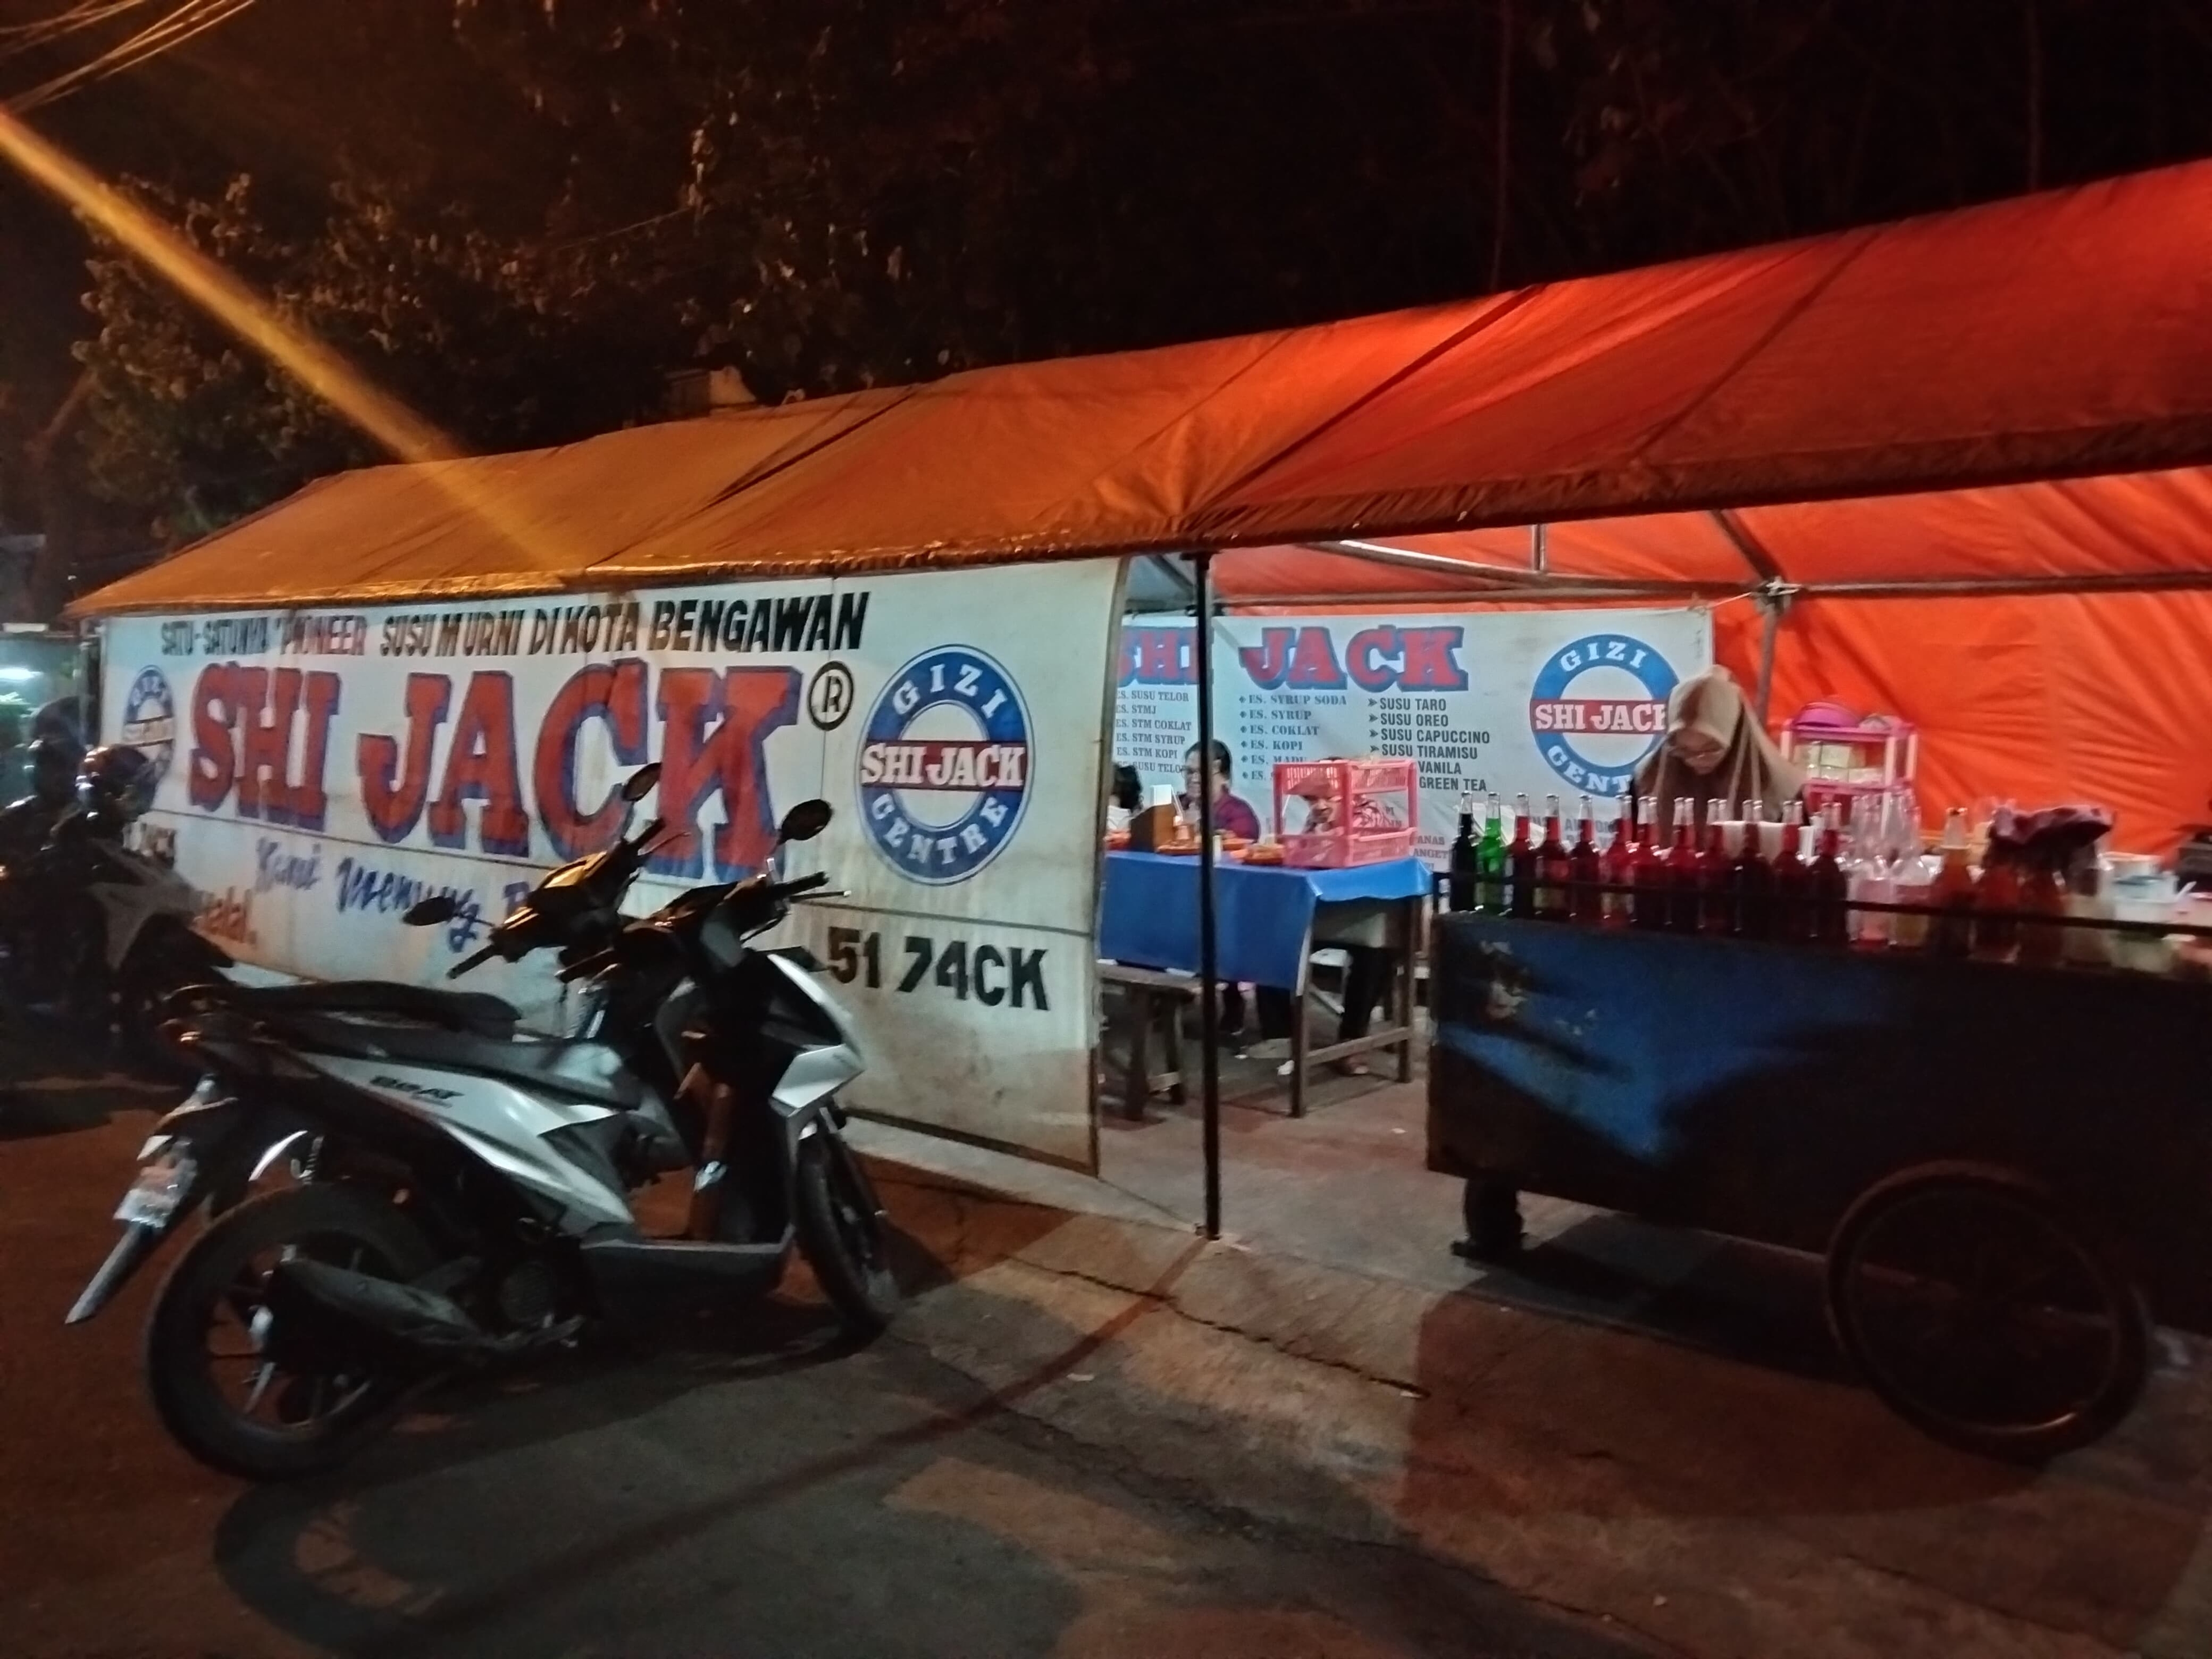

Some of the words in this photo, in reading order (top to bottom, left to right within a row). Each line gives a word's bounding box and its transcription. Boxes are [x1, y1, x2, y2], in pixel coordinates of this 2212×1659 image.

[380, 613, 437, 657] SUSU
[559, 601, 641, 653] KOTA
[647, 591, 870, 653] BENGAWAN
[1238, 624, 1469, 692] JACK
[1560, 641, 1648, 672] GIZI
[892, 664, 1007, 718] GIZI
[1131, 690, 1156, 700] SUSU
[1158, 692, 1189, 702] TELOR
[1270, 694, 1311, 704] SYRUP
[1314, 695, 1347, 706] SODA
[1380, 697, 1411, 710] SUSU
[1415, 698, 1446, 711] TARO
[1131, 704, 1157, 714] STMJ
[1271, 710, 1312, 720] SYRUP
[1535, 703, 1585, 730] SHI
[1131, 718, 1152, 729] STM
[1154, 720, 1191, 731] COKLAT
[1380, 713, 1411, 726] SUSU
[1416, 714, 1449, 727] OREO
[1271, 725, 1320, 736] COKLAT
[1381, 728, 1412, 741] SUSU
[1416, 729, 1490, 744] CAPUCCINO
[1132, 733, 1152, 743] STM
[1154, 734, 1185, 745] SYRUP
[1272, 740, 1303, 751] KOPI
[1132, 747, 1153, 757] STM
[1155, 749, 1178, 759] KOPI
[1382, 744, 1413, 757] SUSU
[1417, 745, 1478, 760] TIRAMISU
[189, 661, 342, 832] SHI
[357, 657, 803, 886] JACK
[861, 744, 927, 785] SHI
[926, 746, 1026, 787] JACK
[1132, 761, 1156, 771] SUSU
[1158, 763, 1185, 774] TELO
[1418, 760, 1462, 775] VANILA
[1548, 745, 1633, 793] CENT
[1419, 777, 1459, 790] GREEN
[1463, 778, 1487, 792] TEA
[871, 793, 1009, 865] CENTRE
